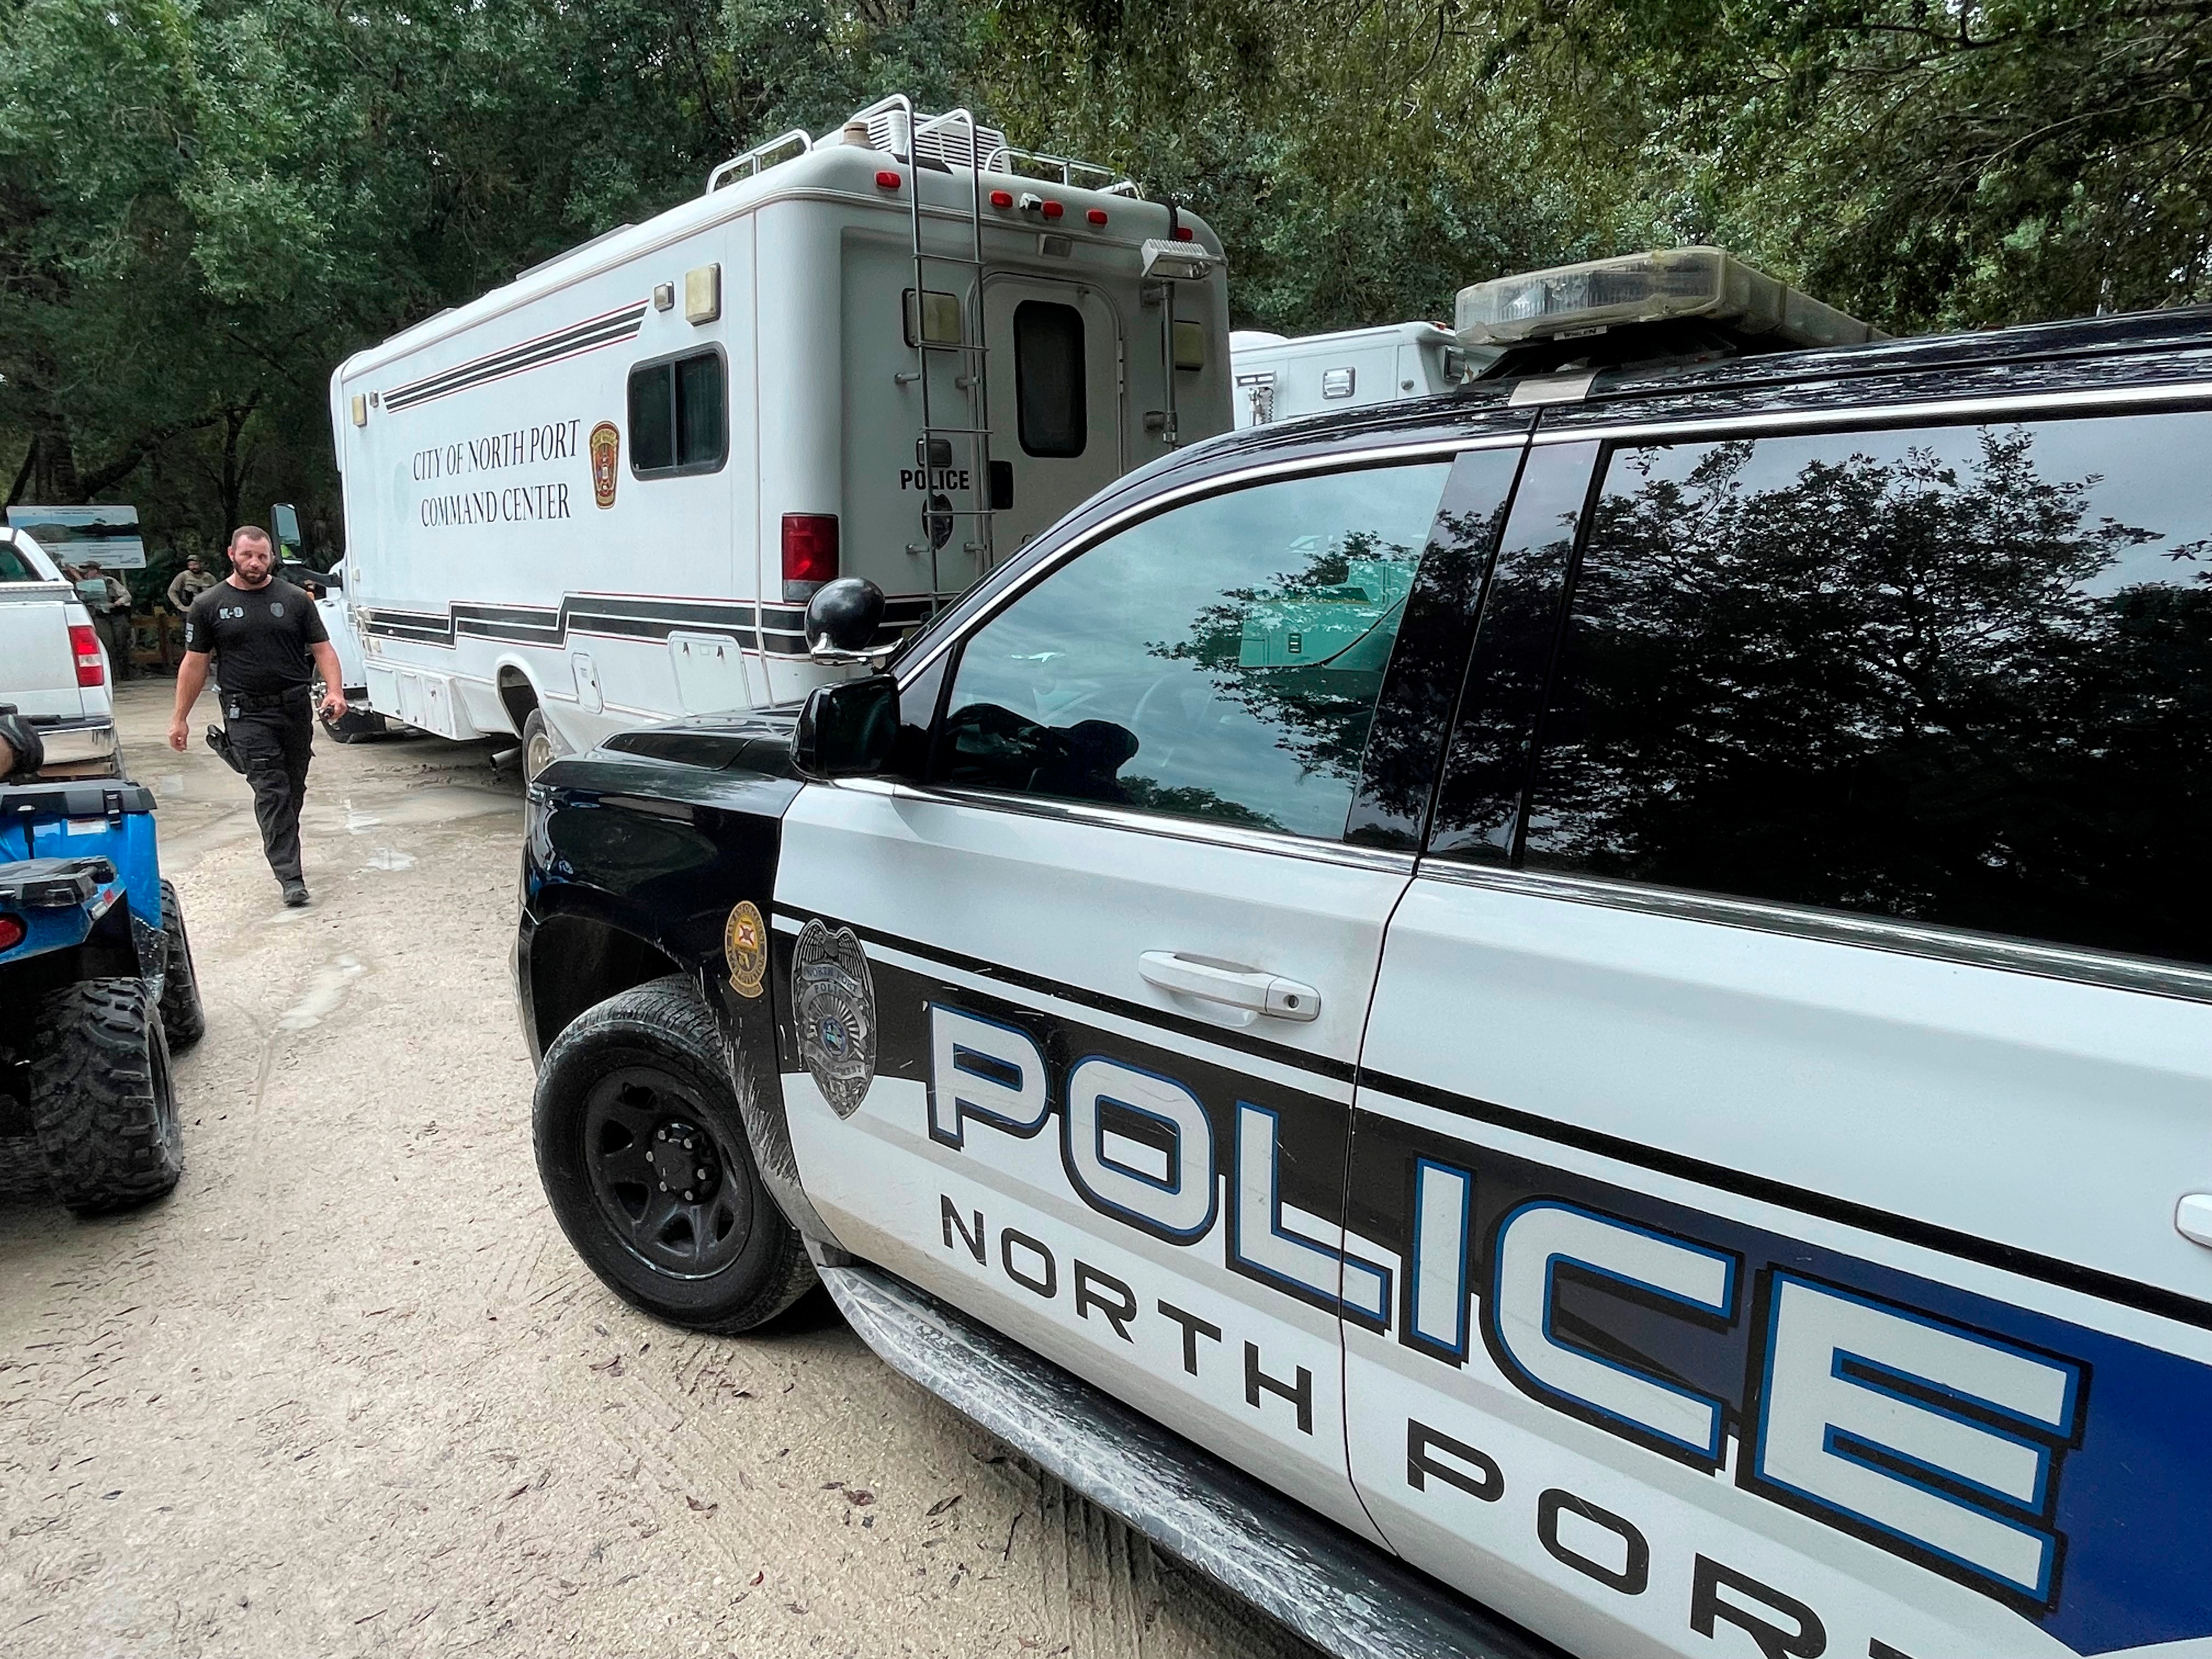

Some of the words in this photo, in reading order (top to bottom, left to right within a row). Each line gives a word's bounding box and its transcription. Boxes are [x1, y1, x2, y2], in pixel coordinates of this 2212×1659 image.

[414, 448, 443, 481] CITY
[447, 443, 464, 476] OF
[468, 430, 525, 472] NORTH
[530, 419, 580, 463] PORT
[421, 491, 497, 527] COMMAND
[503, 483, 571, 521] CENTER
[929, 1001, 2087, 1610] POLICE
[940, 1194, 1313, 1436] NORTH
[1407, 1417, 1920, 1659] POR
